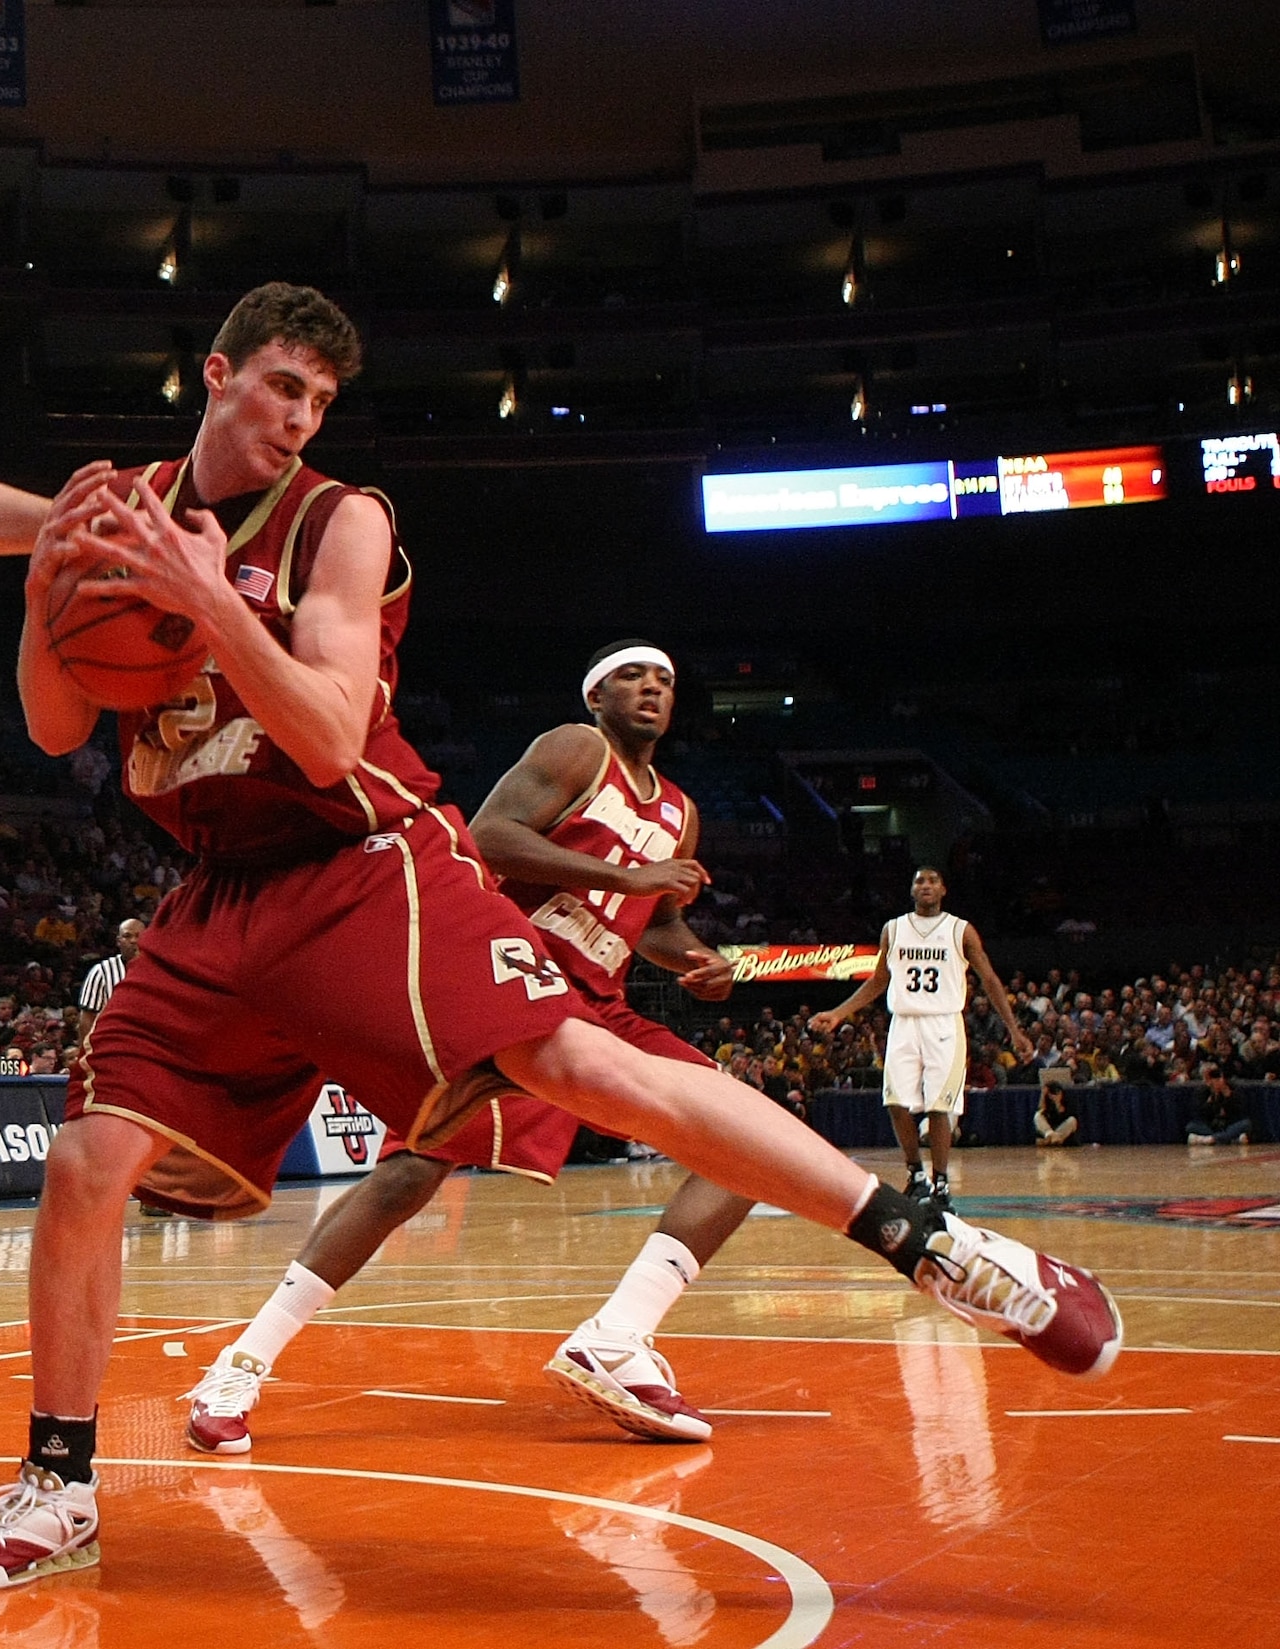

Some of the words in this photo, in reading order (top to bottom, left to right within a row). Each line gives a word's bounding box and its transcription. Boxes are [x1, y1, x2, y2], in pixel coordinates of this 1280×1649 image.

[1207, 476, 1256, 493] FOULS
[732, 944, 835, 983] Budweiser
[899, 948, 948, 961] PURDUE
[906, 966, 939, 993] 33
